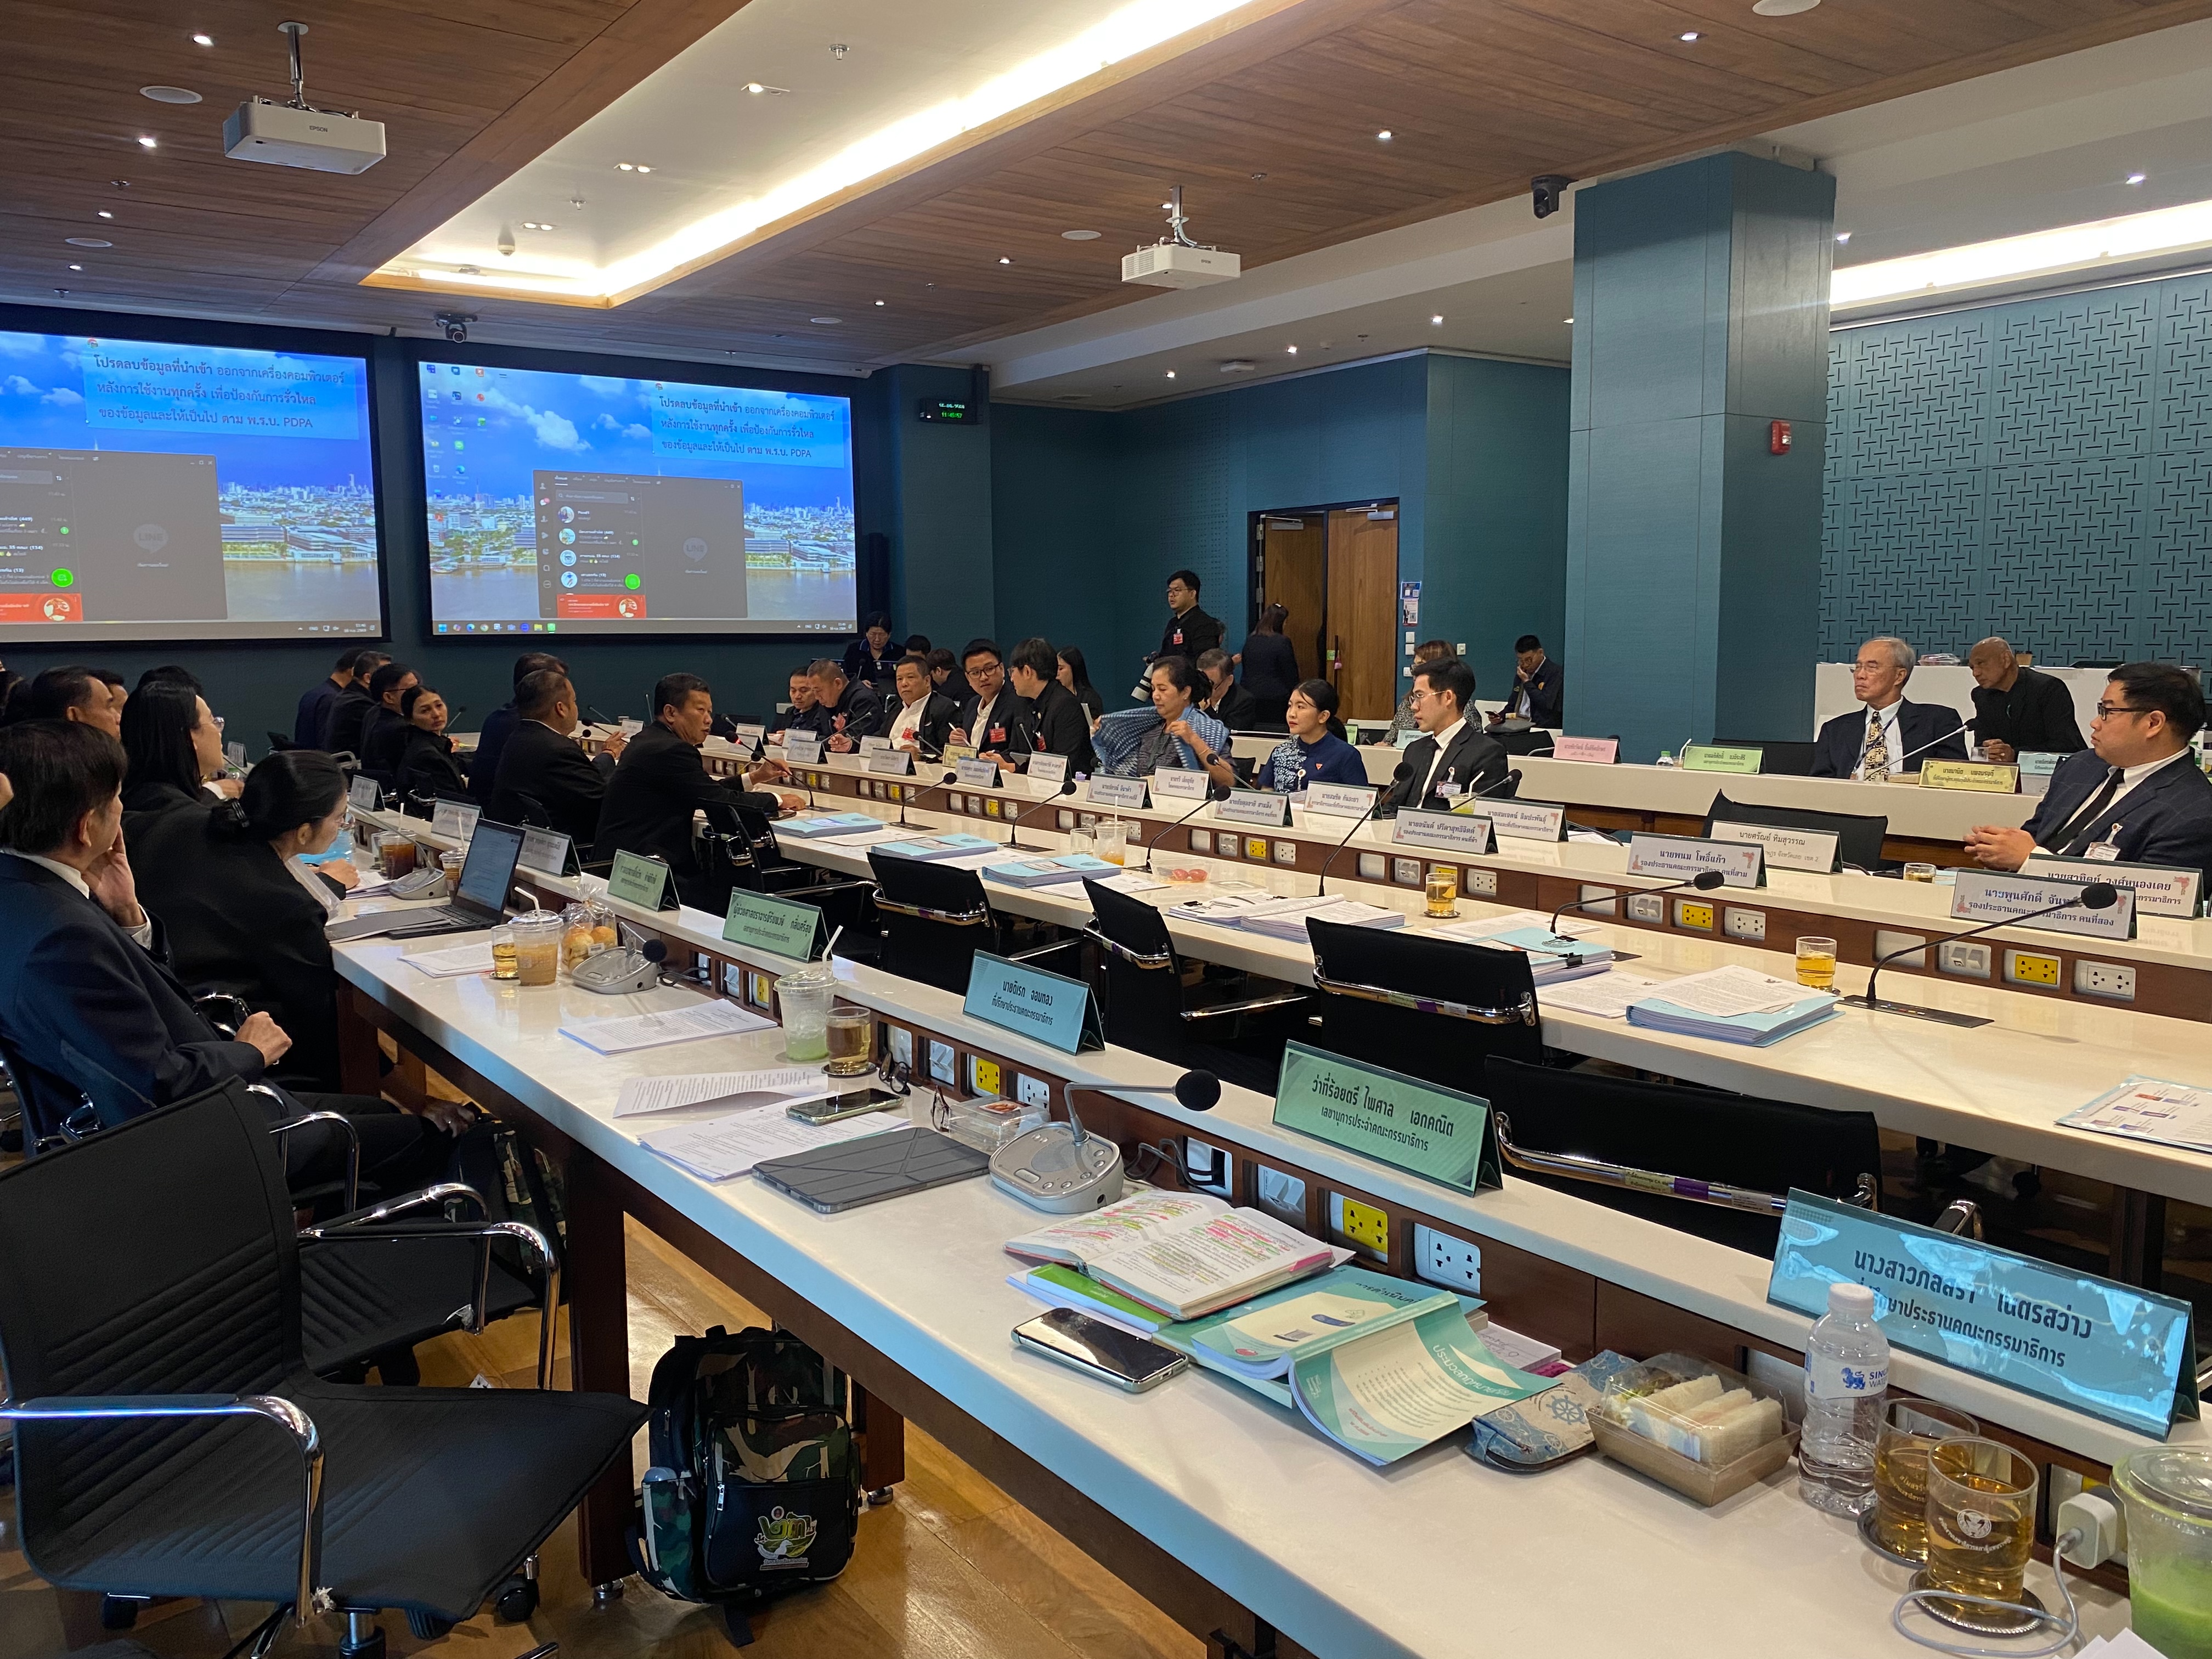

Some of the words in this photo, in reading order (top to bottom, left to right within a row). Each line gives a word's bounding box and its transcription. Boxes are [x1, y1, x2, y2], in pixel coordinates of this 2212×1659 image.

[94, 354, 212, 376] โปรดลบข้อมูลที่นำเข้า
[217, 365, 345, 384] ออกจากเครื่องคอมพิวเตอร์
[97, 381, 207, 401] หลังการใช้งานทุกครั้ง
[211, 387, 316, 405] เพื่อป้องกันการรั่วไหล
[99, 407, 217, 424] ของข้อมูลและให้เป็นไป
[222, 416, 243, 425] ตาม
[247, 416, 280, 427] พ.ร.บ.
[284, 417, 313, 428] PDPA
[659, 396, 742, 414] โปรดลบข้อมูลที่นำเข้า
[745, 405, 835, 421] ออกจากเครื่องคอมพิวเตอร์
[661, 419, 737, 435] หลังการใช้งานทุกครั้ง
[741, 421, 814, 438] เพื่อป้องกันการรั่วไหล
[662, 438, 745, 454] ของข้อมูลและให้เป็นไป
[791, 449, 811, 458] PDPA
[1740, 830, 1771, 842] นายศรัณย์
[1773, 834, 1805, 847] ทิมสุวรรณ
[1660, 849, 1691, 861] นายพนม
[1696, 850, 1726, 864] โพธิ์แก้ว
[1722, 867, 1748, 878] คนที่สาม
[1985, 887, 2042, 904] นายพูนศักดิ์
[1968, 900, 2076, 922] รองประธานคณะกมาธิการ
[2079, 913, 2114, 927] คนที่สอง
[1002, 980, 1025, 997] นายดิเรก
[1031, 990, 1053, 1006] จอมทอง
[991, 992, 1053, 1025] ที่ปรึกษาประธานคณะกรรมาธิการ
[1312, 1073, 1359, 1106] ว่าที่ร้อยตรี
[1363, 1086, 1394, 1117] ไพศาล
[1410, 1109, 1454, 1137] เอกคณิต
[1321, 1105, 1429, 1152] เลขานุการประจำคณะกรรมาธิการ
[1858, 1277, 2066, 1367] ี่รึกษาประธานคณะกรรมาธิการ
[1869, 1368, 1888, 1380] SING
[1869, 1378, 1887, 1387] WATE
